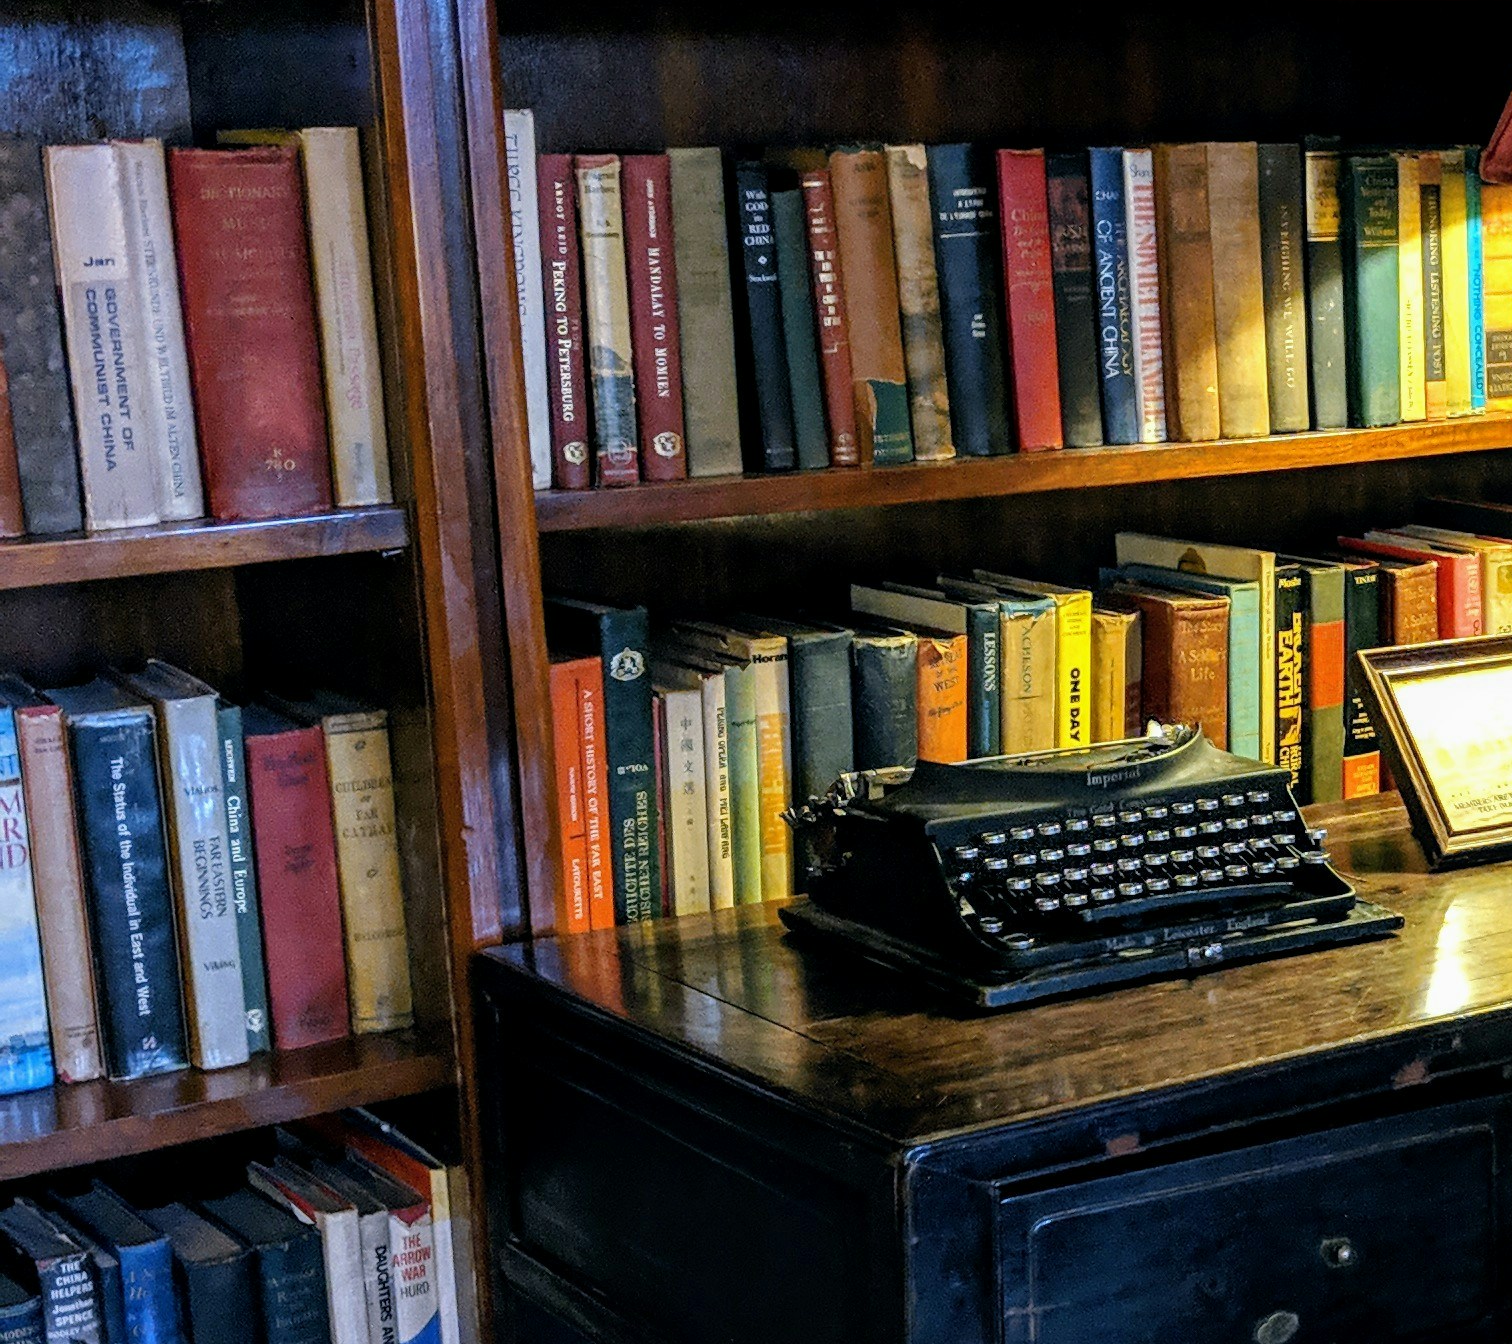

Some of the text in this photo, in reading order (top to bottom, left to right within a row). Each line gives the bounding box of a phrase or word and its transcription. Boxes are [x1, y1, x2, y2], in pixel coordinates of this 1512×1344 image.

[745, 189, 767, 200] With
[745, 201, 769, 212] GOD
[749, 224, 770, 234] RED
[83, 257, 115, 269] Jan
[552, 181, 575, 422] ARNOT REID PEKING TO PETERSBURG
[1097, 219, 1120, 380] OF ANCIENT CHINA
[1132, 184, 1165, 423] THE SOVIET TRIANGLE
[1282, 297, 1293, 320] WE
[1430, 271, 1443, 340] LISTENING
[1285, 323, 1294, 364] WILL
[104, 287, 136, 453] GOVERNMENT OF
[1433, 344, 1443, 376] POST
[85, 287, 118, 472] COMMUNIST CHINA
[1287, 366, 1296, 389] GO
[752, 654, 789, 664] Horan
[983, 632, 996, 692] LESSONS
[1022, 624, 1033, 693] ACHESON
[1279, 629, 1295, 707] EARTH
[934, 675, 961, 692] WEST
[1190, 667, 1216, 681] Life
[1070, 667, 1081, 742] ONE DAY
[1086, 764, 1141, 788] Imperial
[1288, 746, 1301, 789] RURAL
[582, 689, 604, 901] A SHORT HISTORY OF THE FAR EAST
[227, 795, 241, 835] China
[355, 809, 378, 822] FAR
[635, 790, 648, 856] REICHES
[230, 840, 242, 864] and
[111, 755, 151, 1017] The Status of the Individual in East and West
[192, 840, 213, 920] BEGINNINGS
[208, 835, 228, 918] FAR EASTERN
[571, 858, 585, 920] LATOURETTE
[232, 868, 248, 915] Europe
[204, 961, 236, 973] Viking
[402, 1233, 422, 1251] THE
[60, 1261, 81, 1274] THE
[391, 1246, 432, 1268] ARROW
[55, 1270, 88, 1287] CHINA
[375, 1245, 392, 1323] DAUGHTERS
[401, 1268, 427, 1282] WAR
[51, 1281, 94, 1300] HELPERS
[400, 1281, 430, 1300] HURD
[52, 1298, 94, 1315] Jonathan
[54, 1309, 94, 1327] SPENCE
